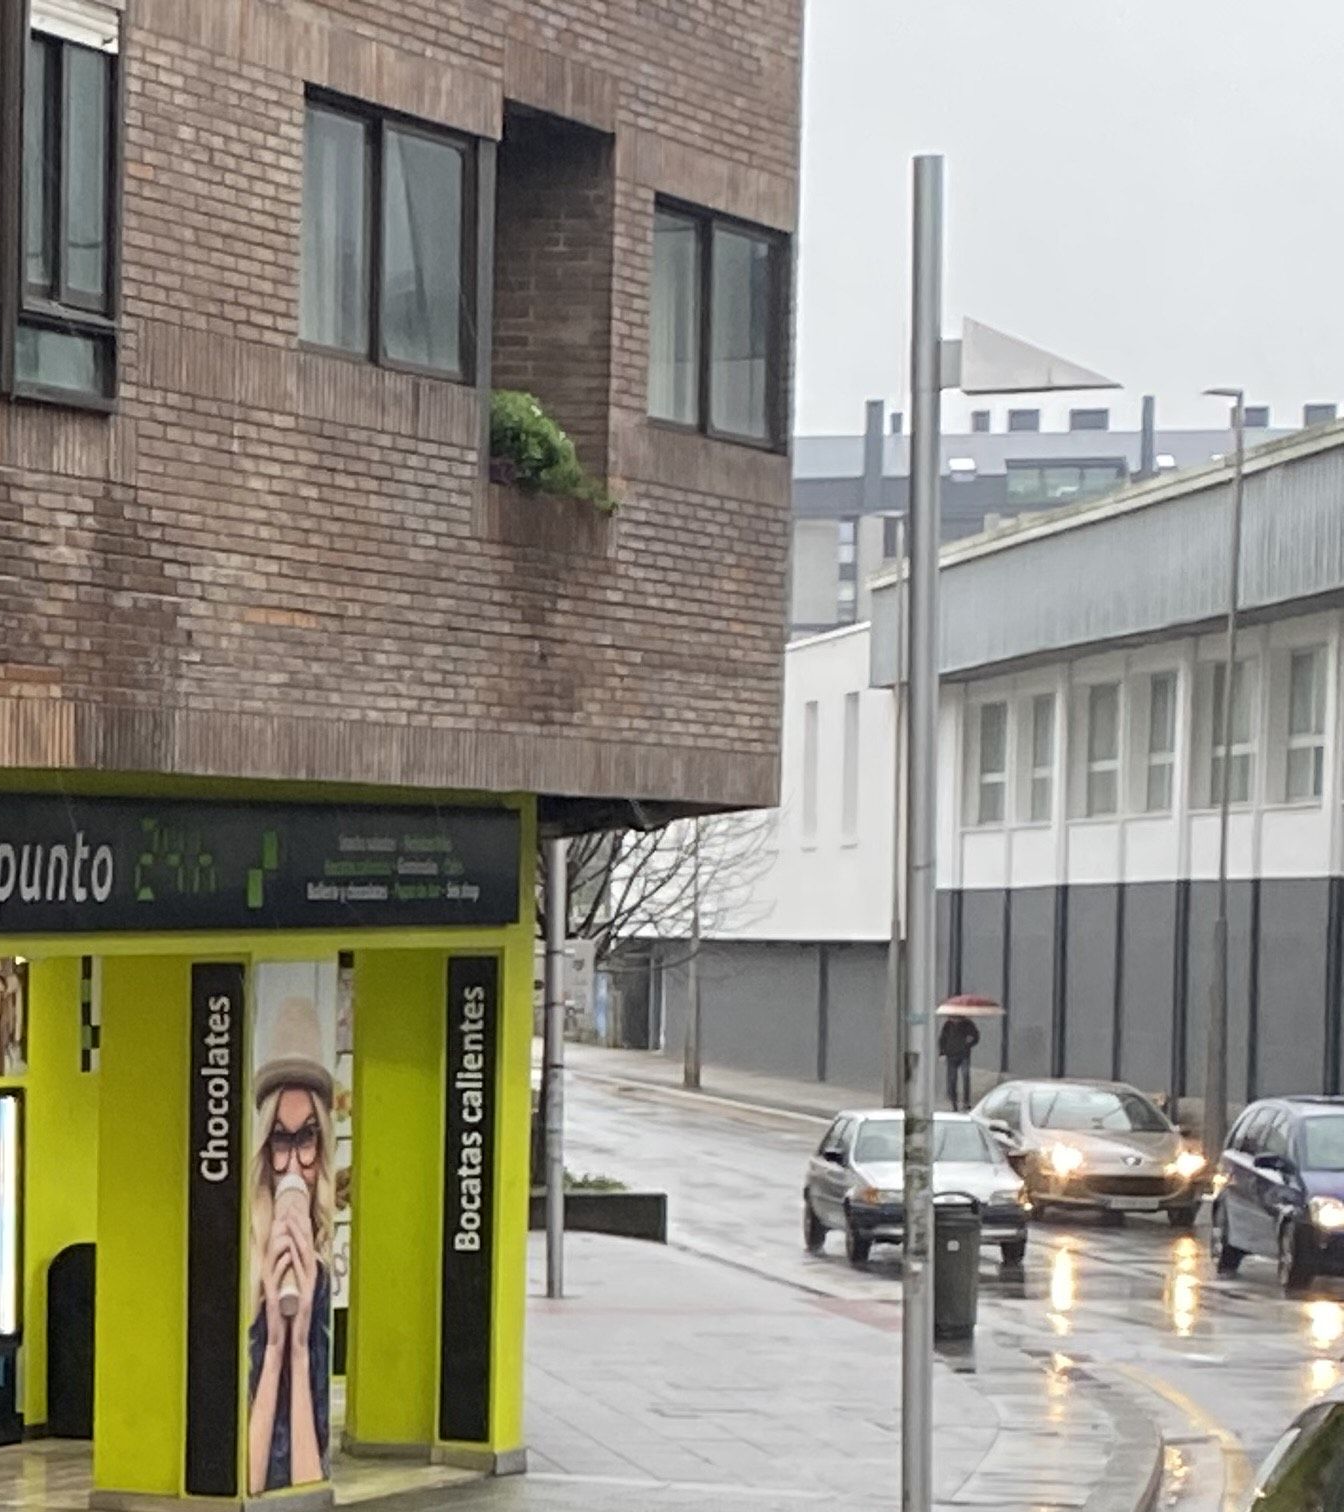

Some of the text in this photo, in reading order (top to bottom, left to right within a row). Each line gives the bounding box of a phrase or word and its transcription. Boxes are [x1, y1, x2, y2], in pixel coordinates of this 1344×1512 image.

[200, 995, 230, 1182] Chocolates
[454, 986, 485, 1251] Bocatas calientes
